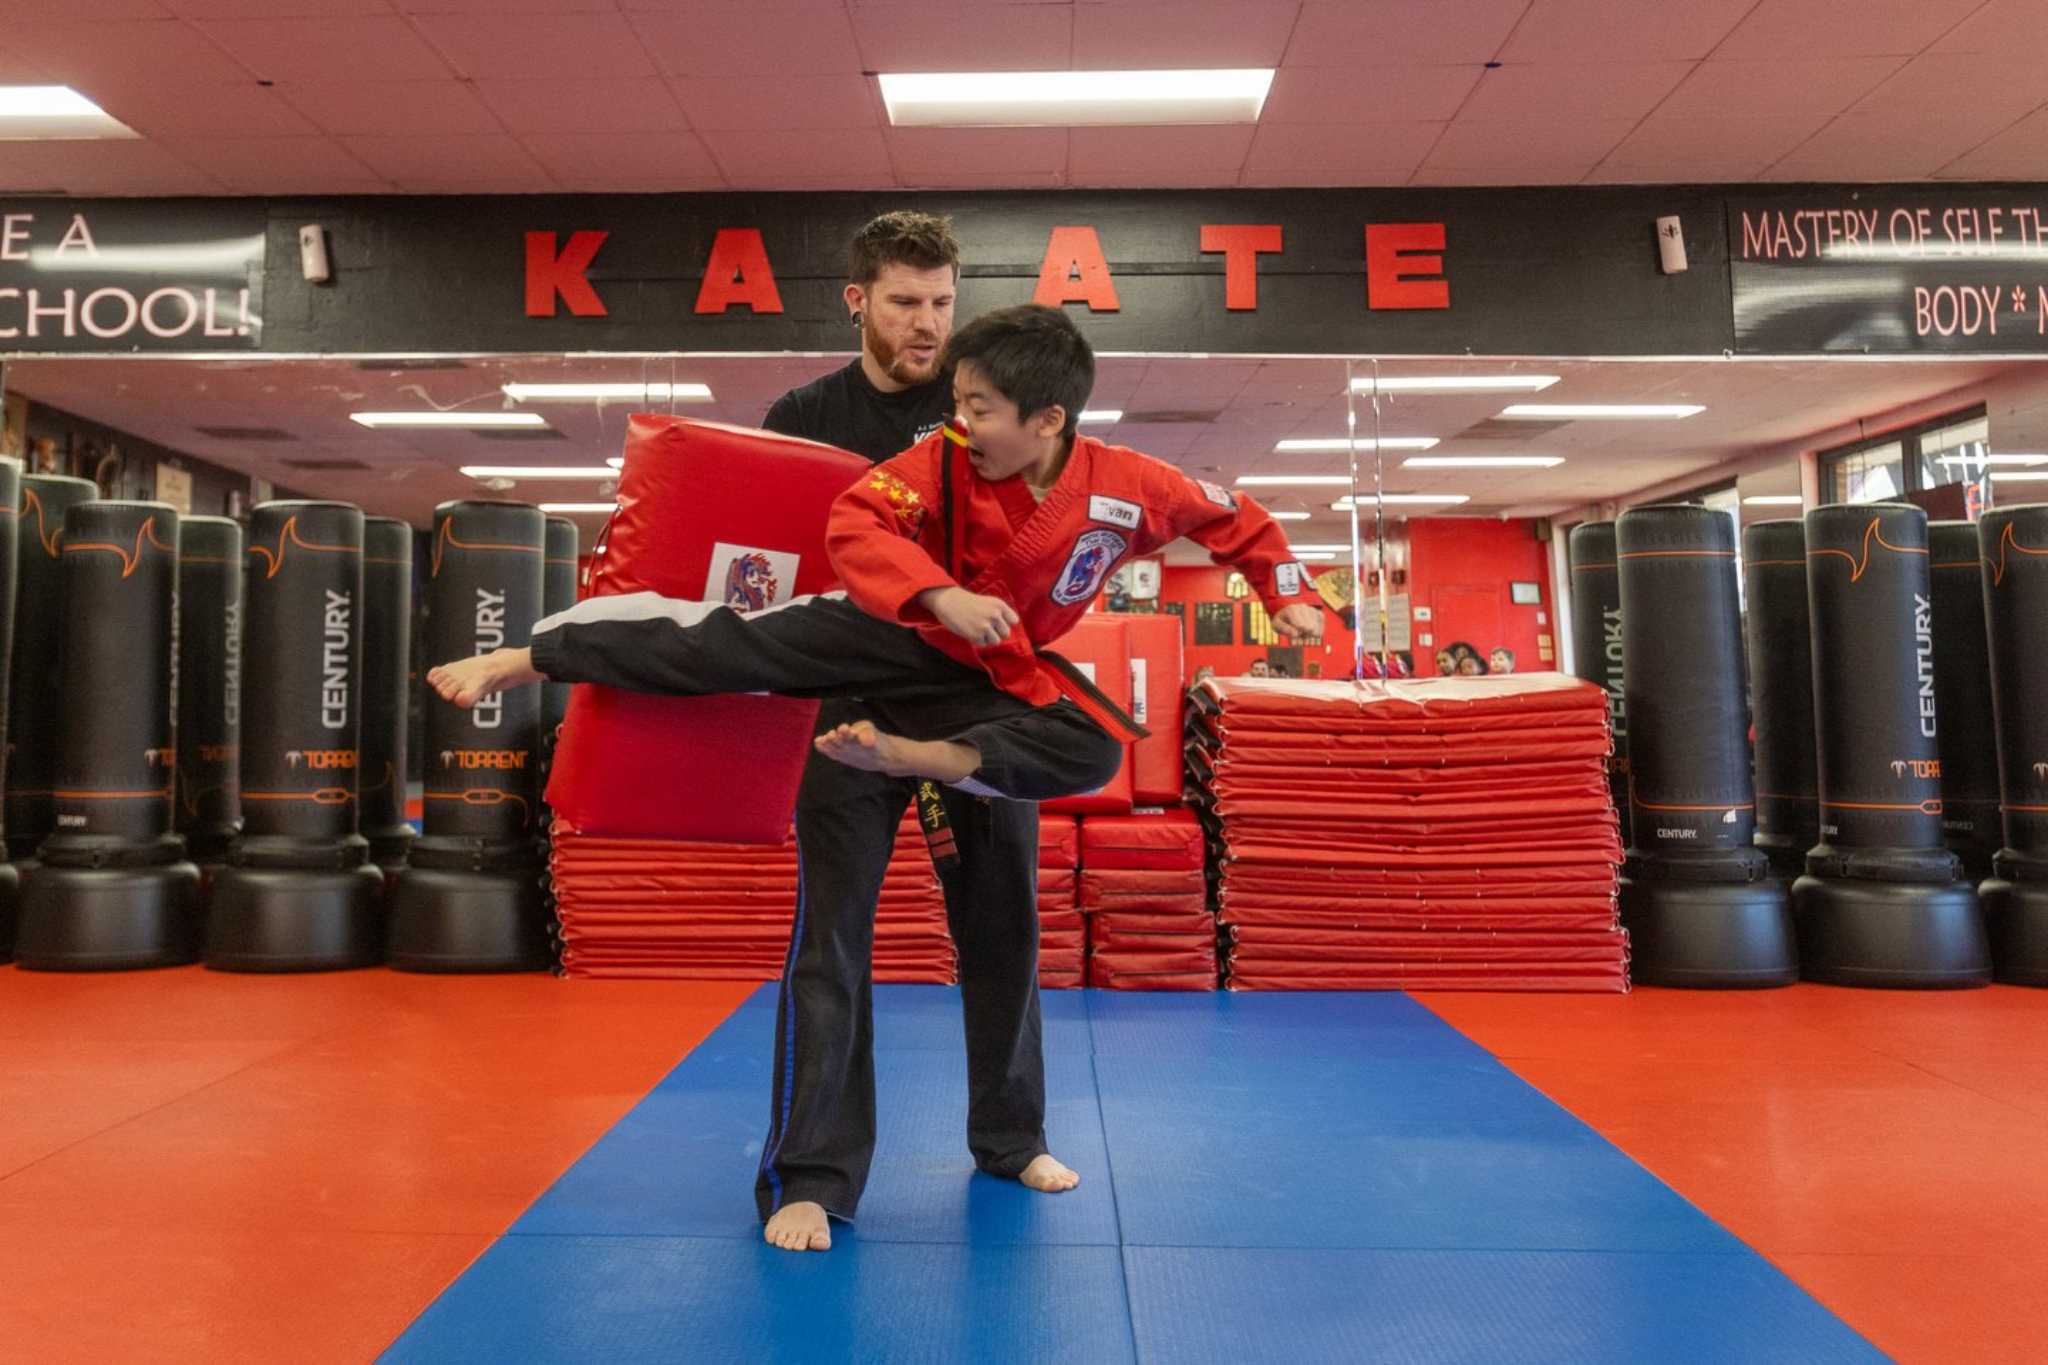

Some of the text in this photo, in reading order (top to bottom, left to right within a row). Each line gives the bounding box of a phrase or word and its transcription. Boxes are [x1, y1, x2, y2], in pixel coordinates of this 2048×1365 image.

[53, 213, 101, 259] A
[1742, 209, 1878, 259] MASTERY
[1889, 208, 1932, 257] OF
[1942, 207, 2004, 257] SELF
[1915, 286, 2001, 335] BODY
[455, 751, 528, 769] TORRENT
